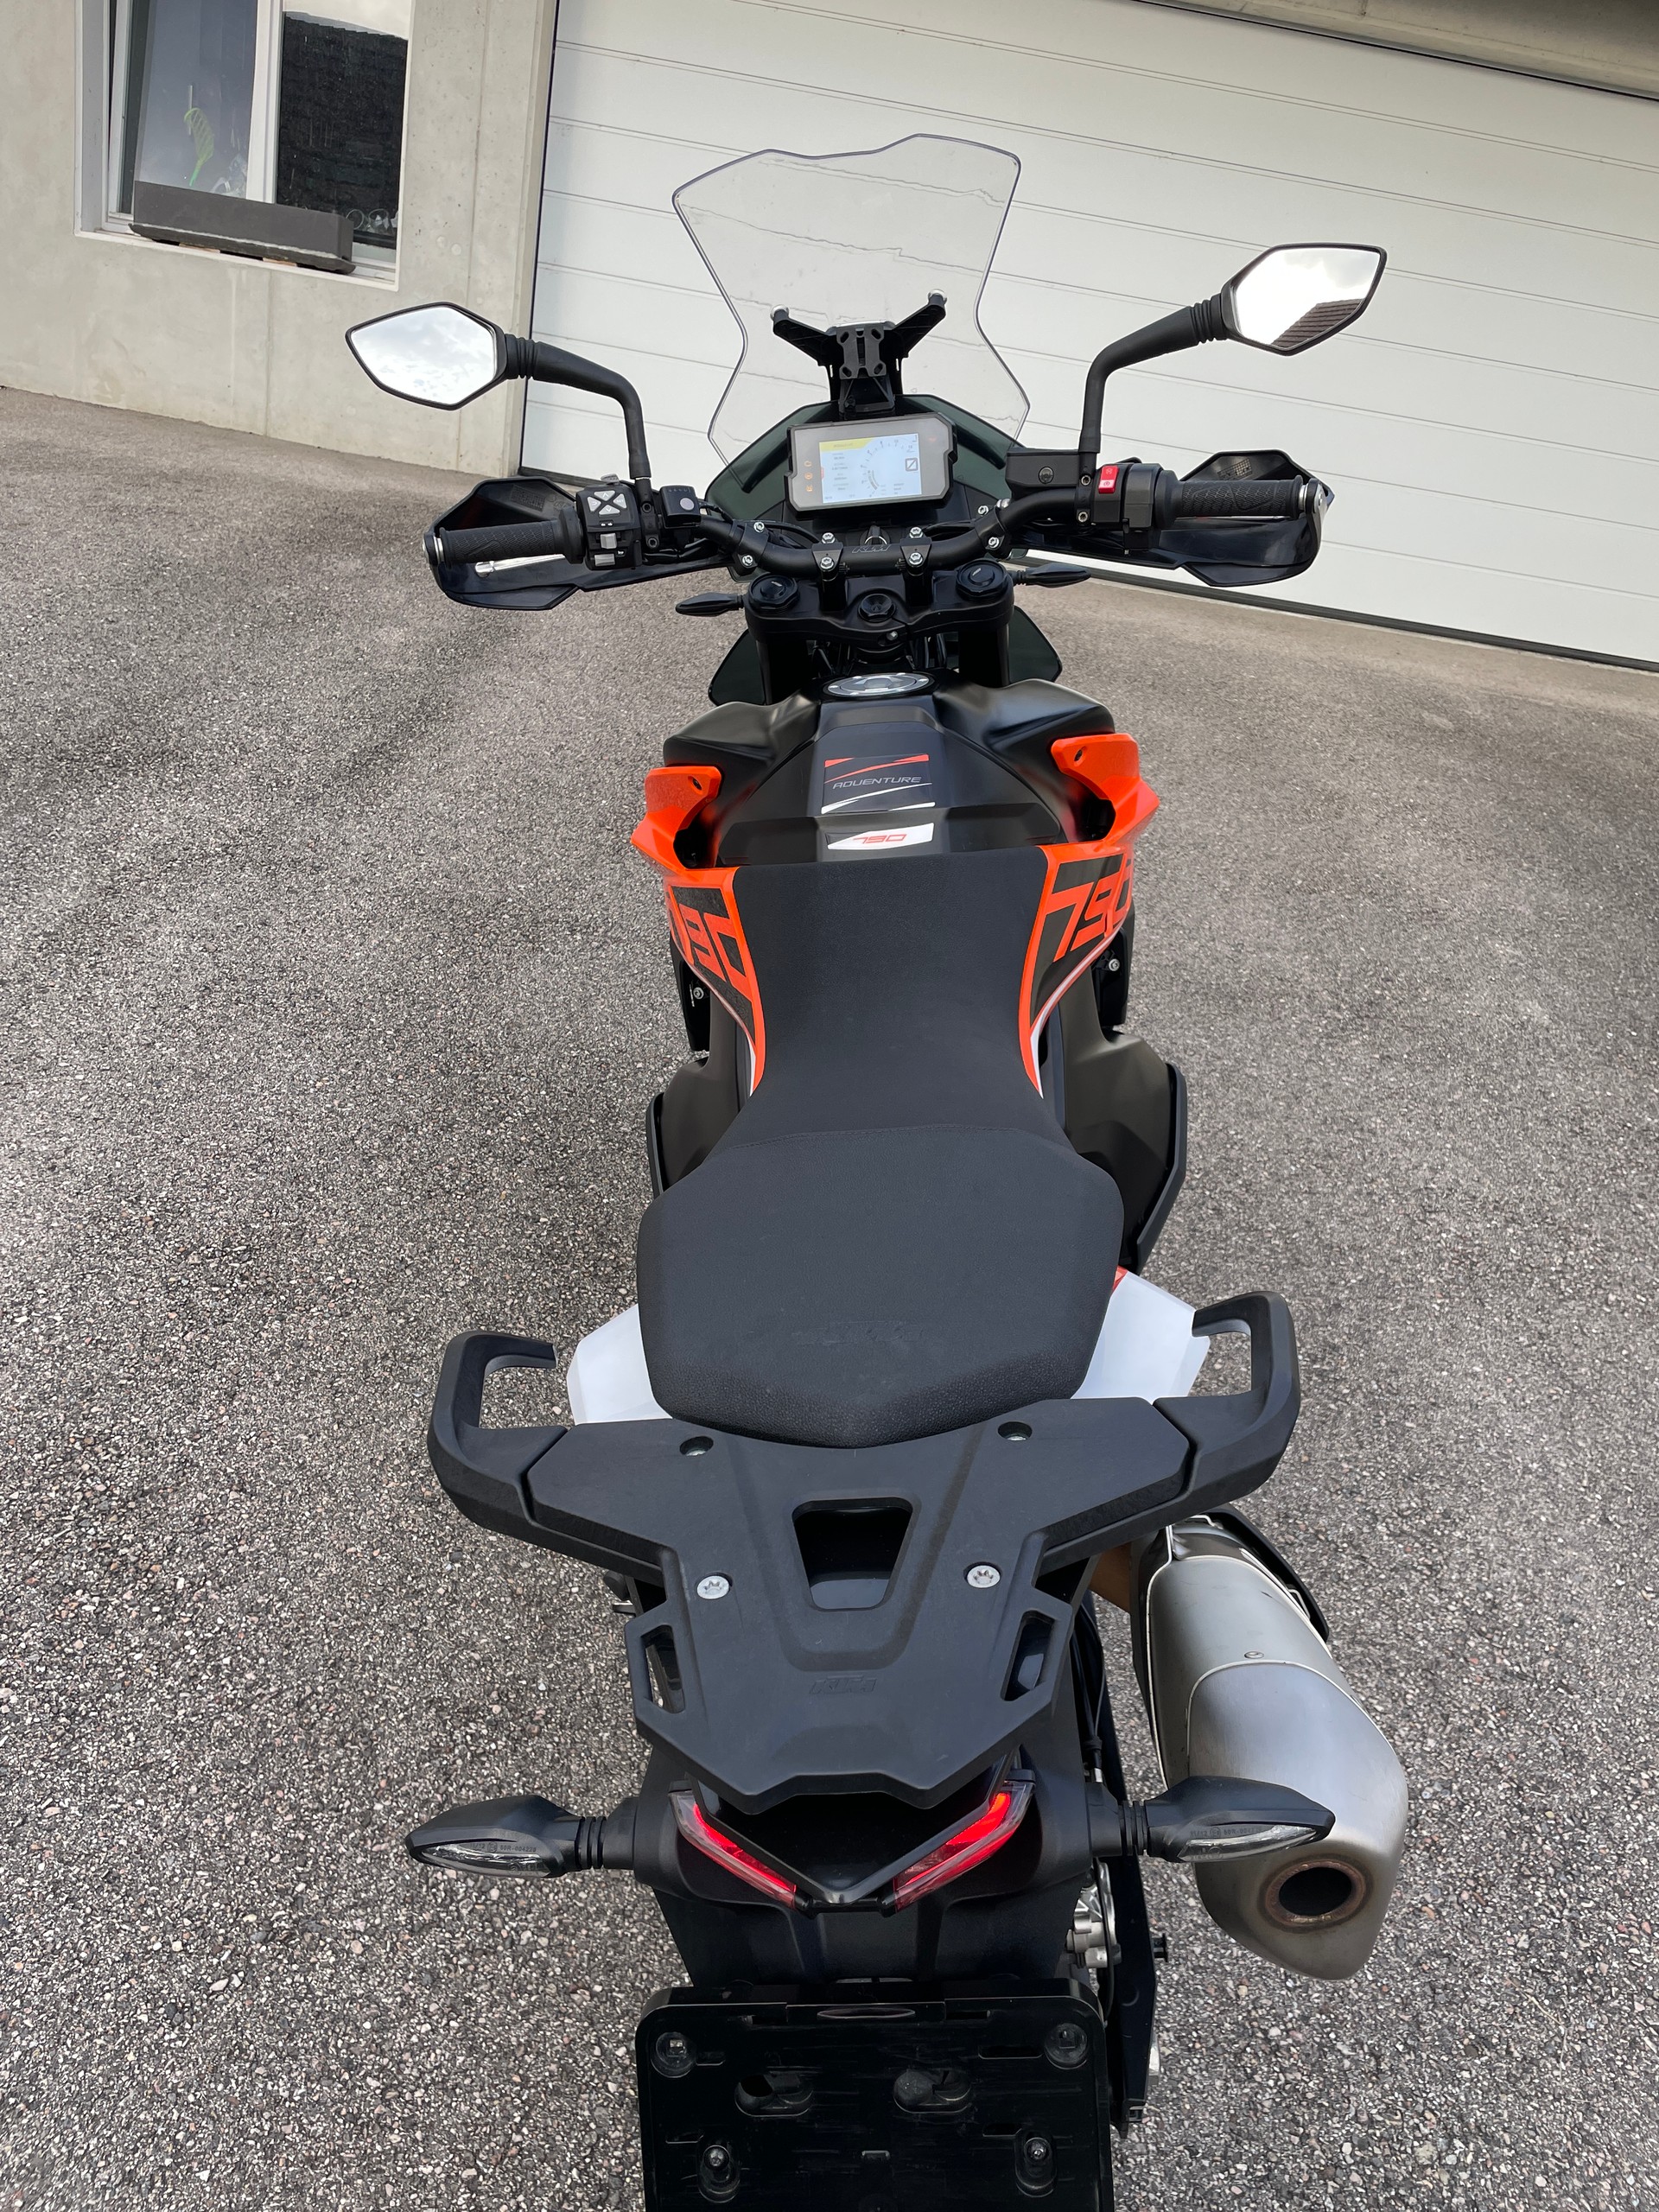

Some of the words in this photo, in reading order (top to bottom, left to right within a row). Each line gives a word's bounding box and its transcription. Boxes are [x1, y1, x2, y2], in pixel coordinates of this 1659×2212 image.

[832, 776, 922, 790] ADVENTURE
[853, 833, 907, 844] 790
[1042, 864, 1134, 963] 790
